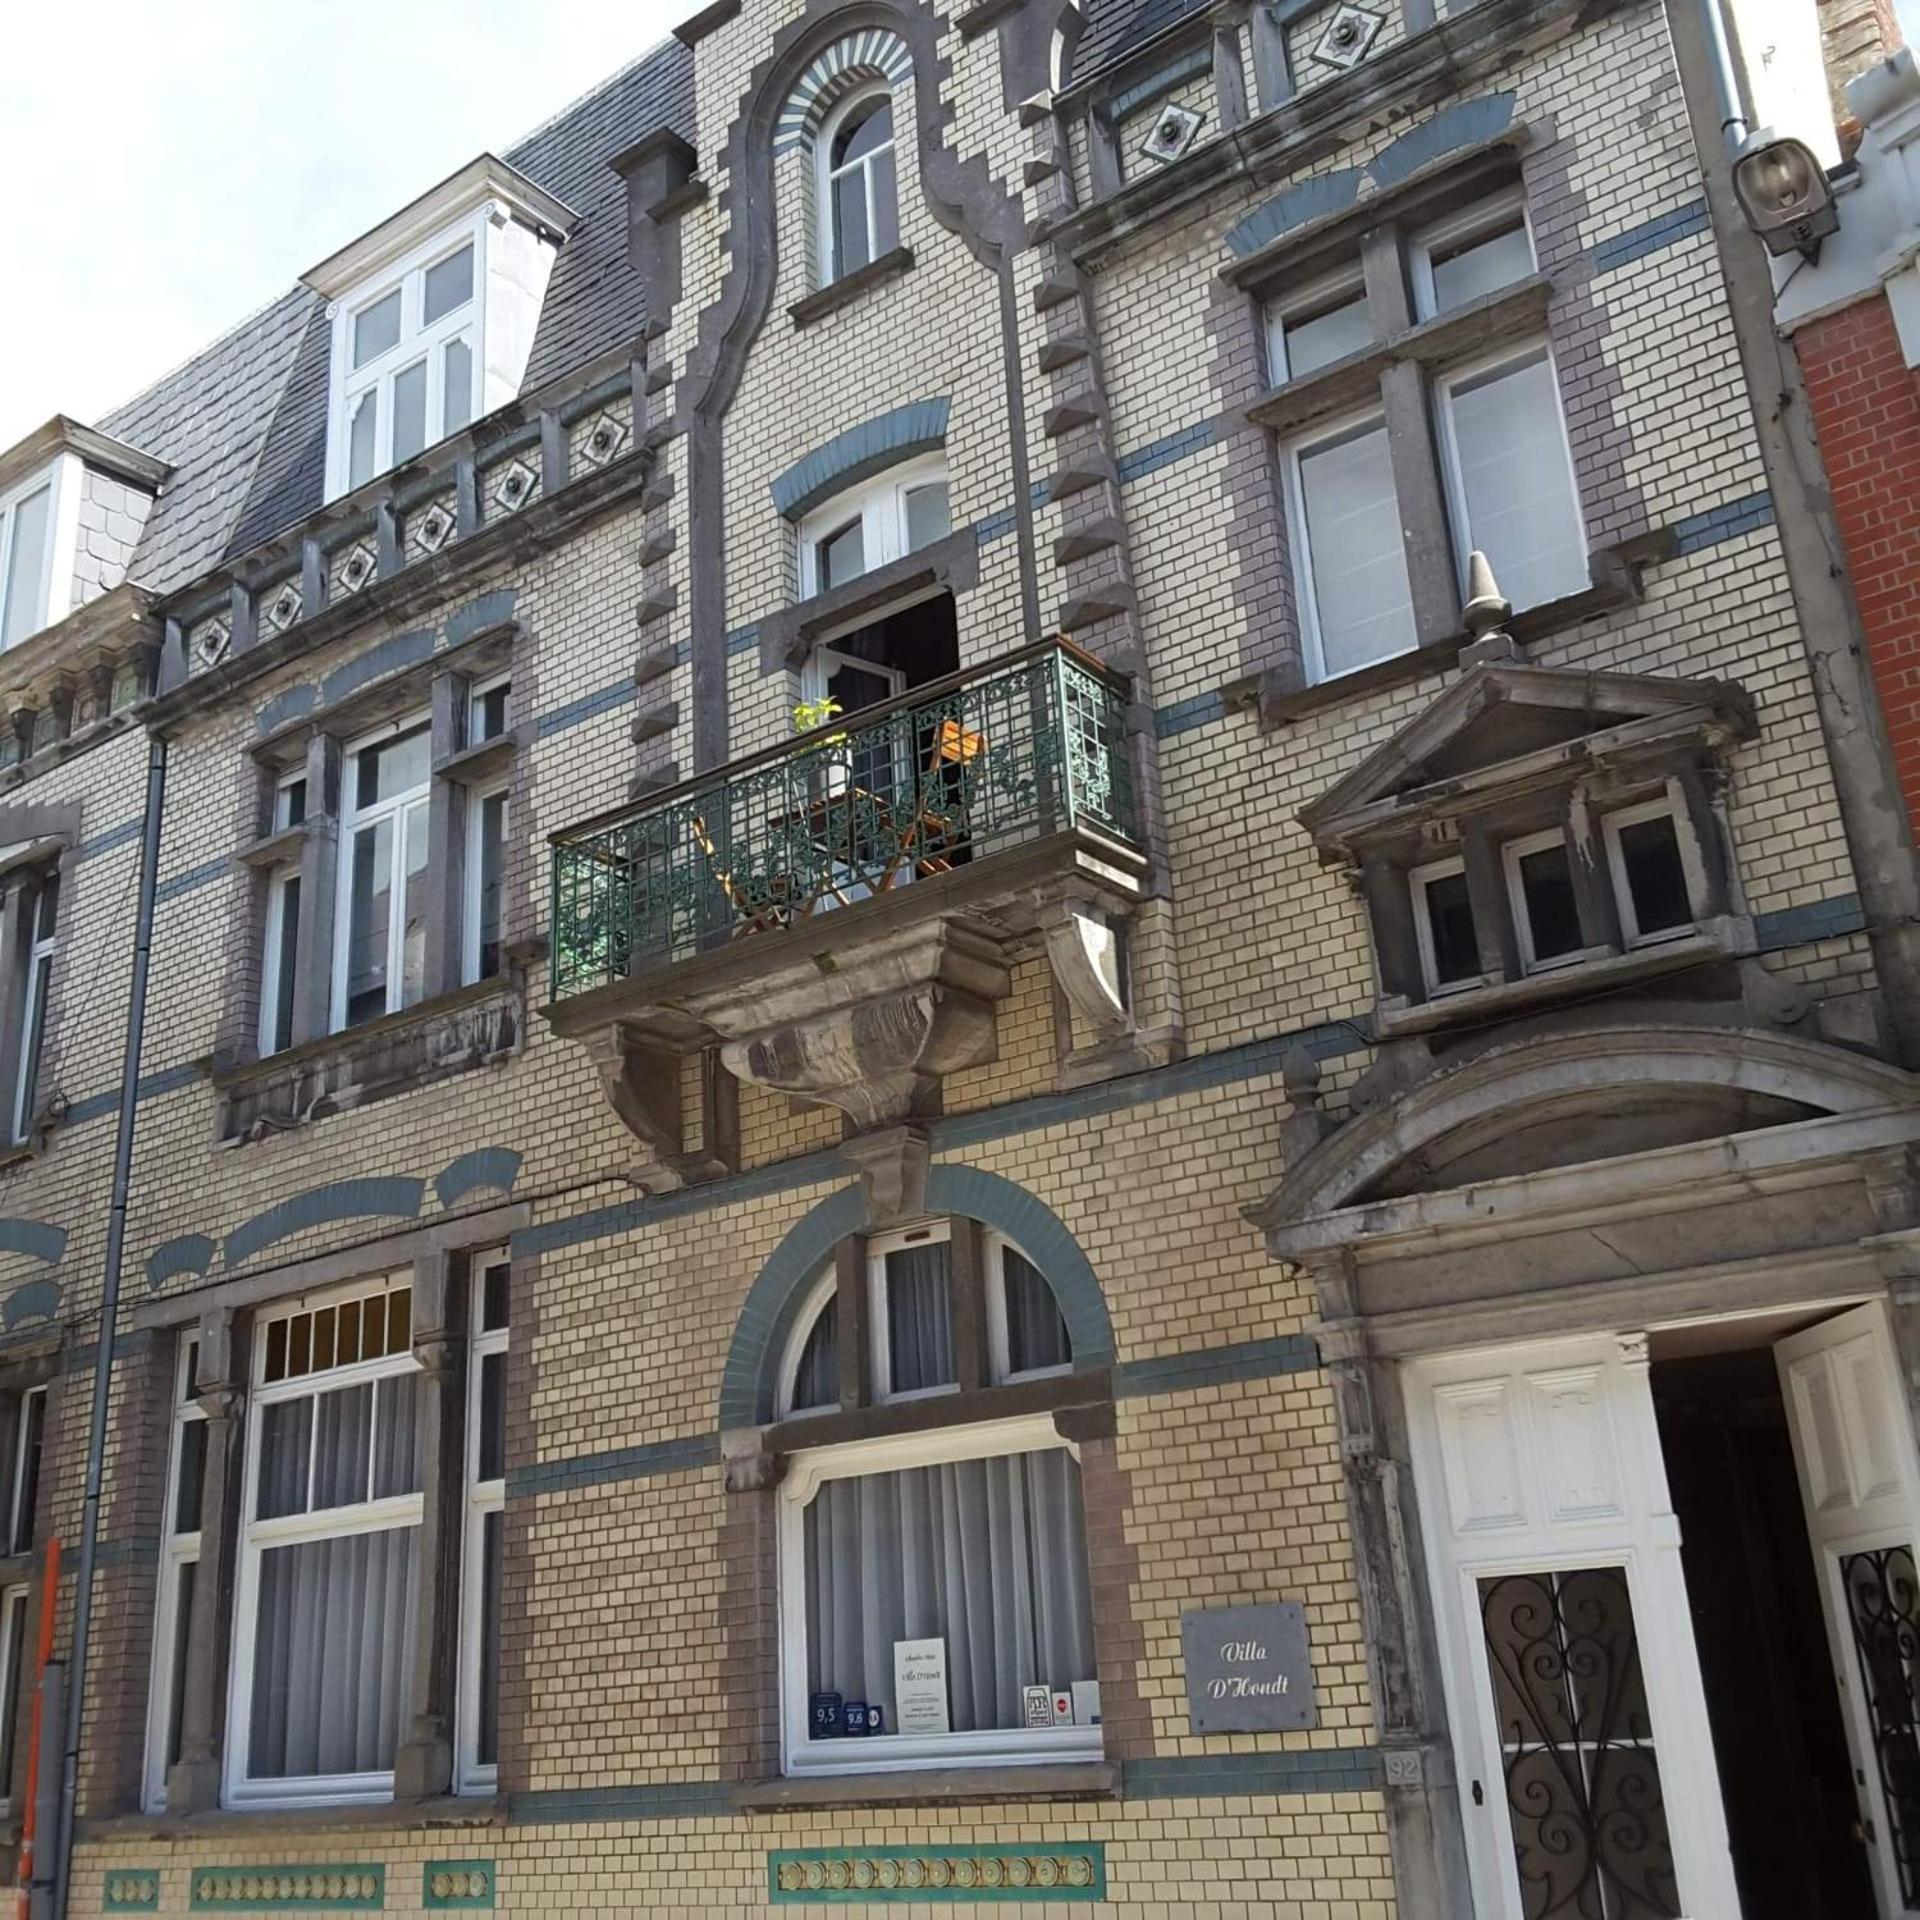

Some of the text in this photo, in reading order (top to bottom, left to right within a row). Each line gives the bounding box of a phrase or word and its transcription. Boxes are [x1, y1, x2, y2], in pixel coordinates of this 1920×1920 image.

[1220, 1640, 1268, 1663] Villa
[1207, 1675, 1289, 1699] D'Hondt
[817, 1707, 836, 1724] 9,5
[1391, 1758, 1418, 1778] 92
